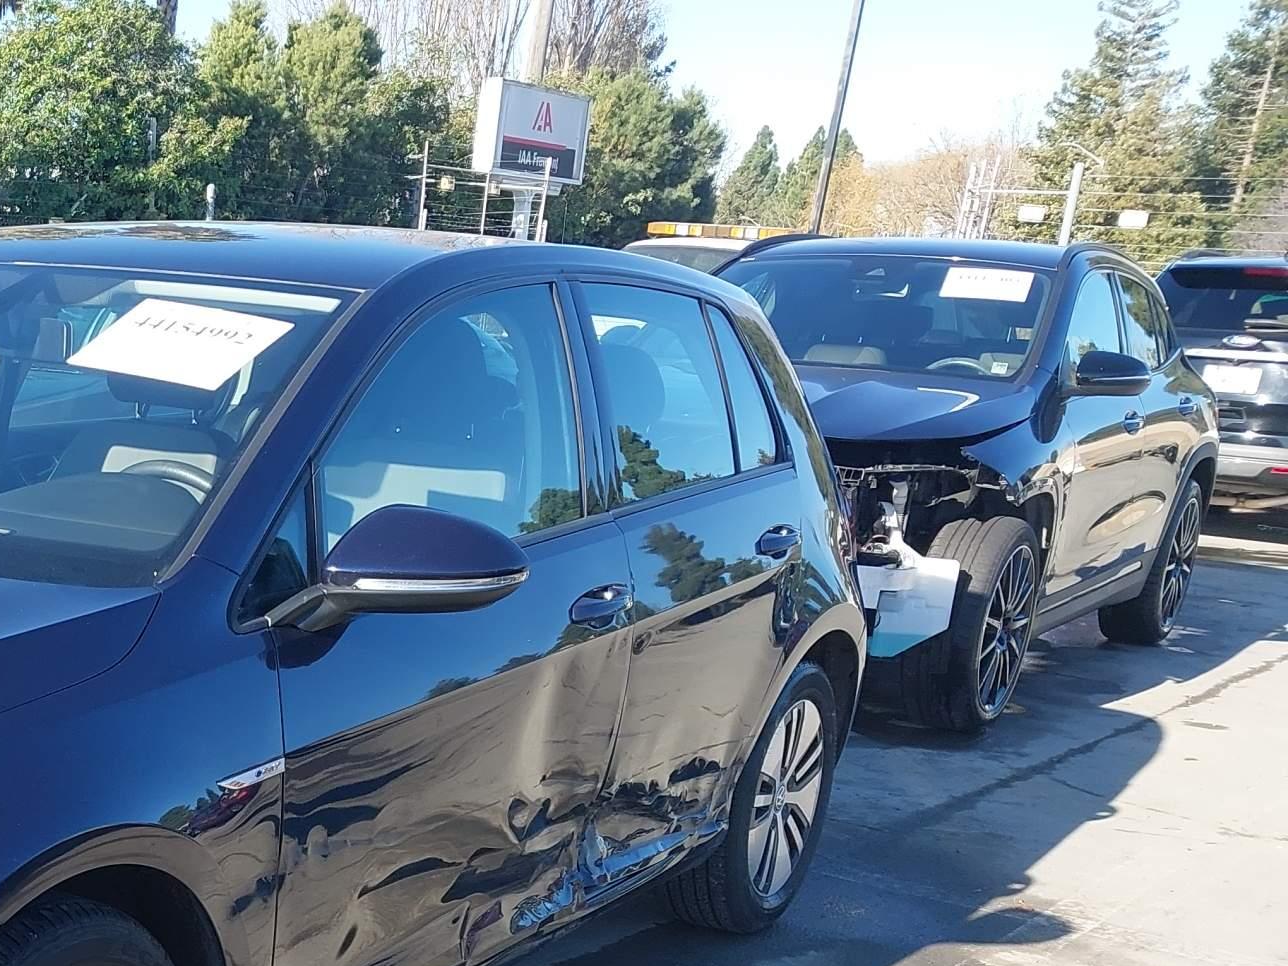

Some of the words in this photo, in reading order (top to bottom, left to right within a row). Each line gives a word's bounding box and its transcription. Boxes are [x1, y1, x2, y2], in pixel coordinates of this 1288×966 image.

[518, 149, 532, 166] IAA
[532, 151, 560, 173] Frent
[134, 316, 254, 345] 44154992
